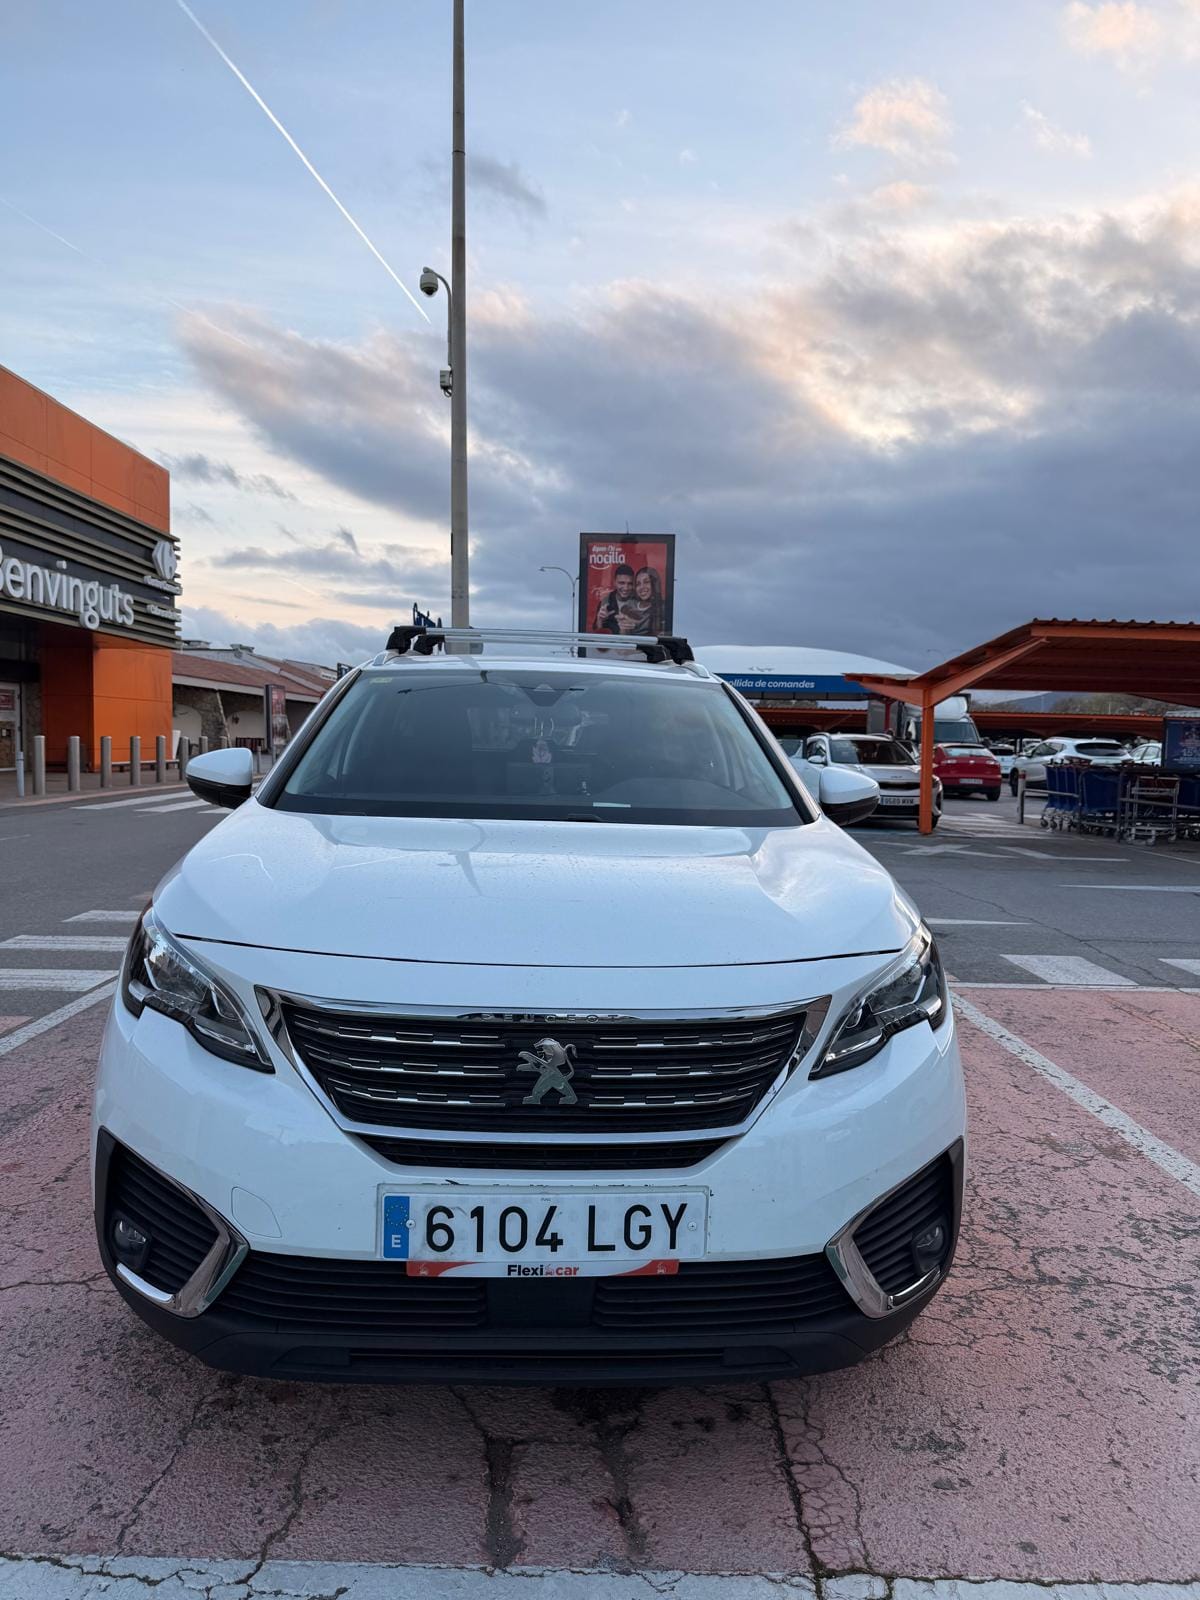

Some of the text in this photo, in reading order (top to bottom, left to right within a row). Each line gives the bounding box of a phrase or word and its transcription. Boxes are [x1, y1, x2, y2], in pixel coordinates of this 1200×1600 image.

[0, 545, 135, 630] envinguts
[727, 679, 815, 689] ollida de comandes
[480, 1012, 621, 1024] PEUGEOT
[425, 1202, 689, 1254] 6104 LGY
[391, 1234, 402, 1248] E
